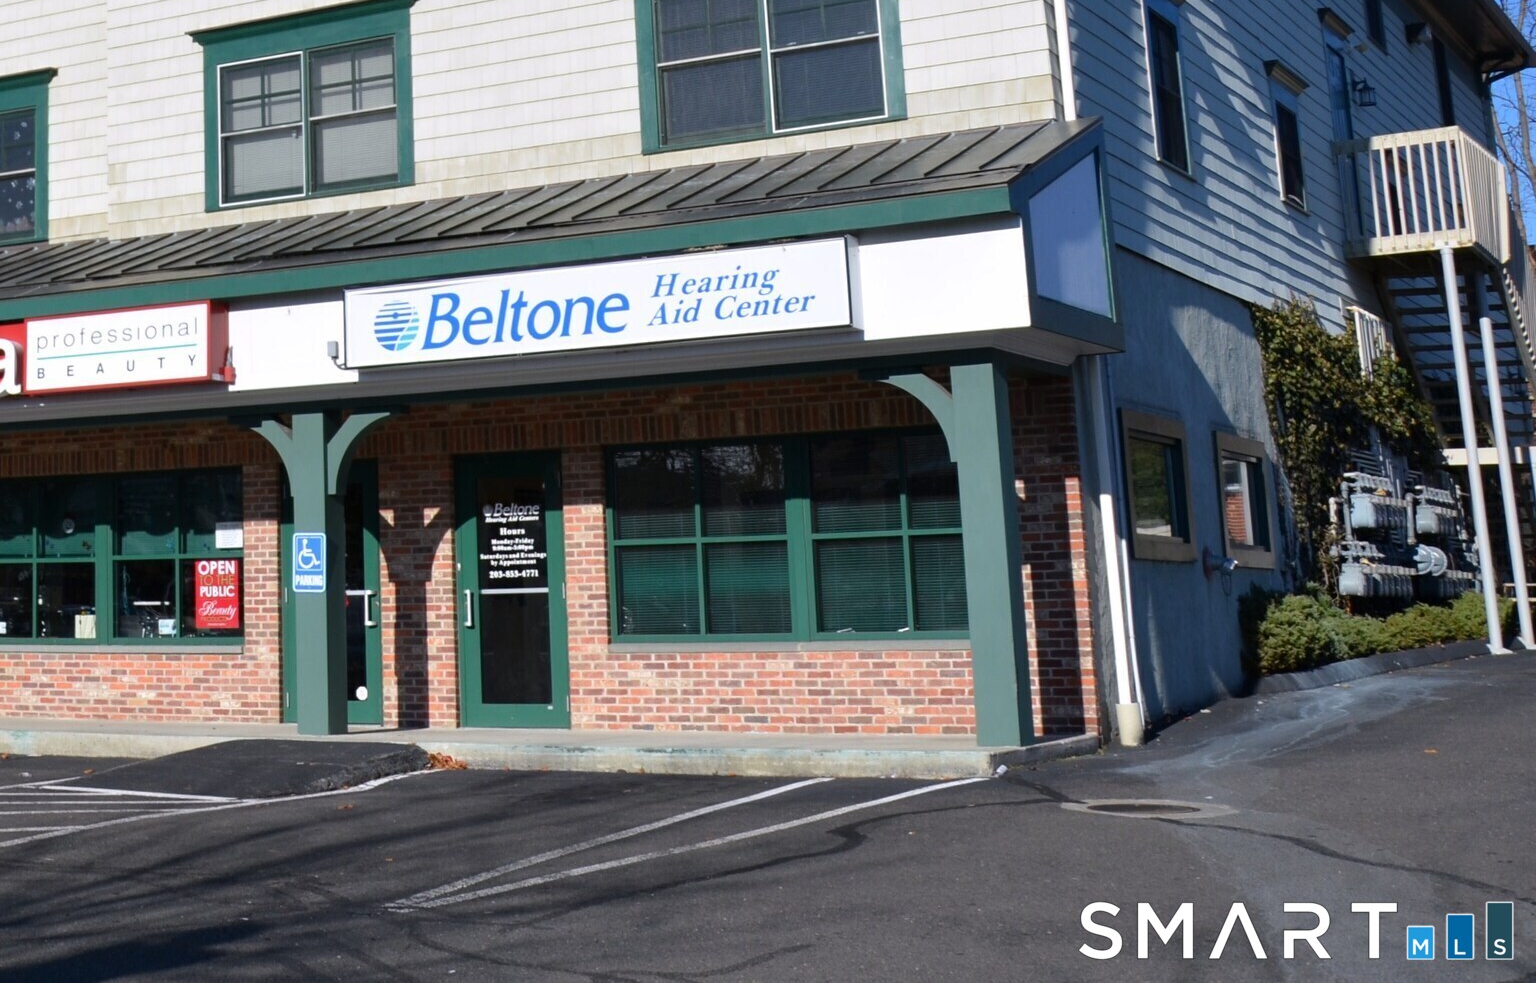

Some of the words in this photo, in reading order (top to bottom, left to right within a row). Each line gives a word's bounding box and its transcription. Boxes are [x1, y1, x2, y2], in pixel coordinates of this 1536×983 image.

[652, 265, 779, 297] Hearing
[647, 298, 701, 327] Aid
[714, 291, 816, 320] Center
[421, 289, 630, 351] Beltone
[36, 317, 198, 353] professional
[37, 354, 196, 379] BEAUTY
[493, 503, 540, 517] Beltone
[499, 527, 525, 536] Hours
[198, 560, 235, 575] OPEN
[499, 559, 537, 567] Appointment
[199, 575, 213, 585] TO
[216, 574, 235, 585] THE
[295, 574, 323, 586] PARKING
[199, 585, 235, 597] PUBLIC
[198, 600, 237, 620] Beauty
